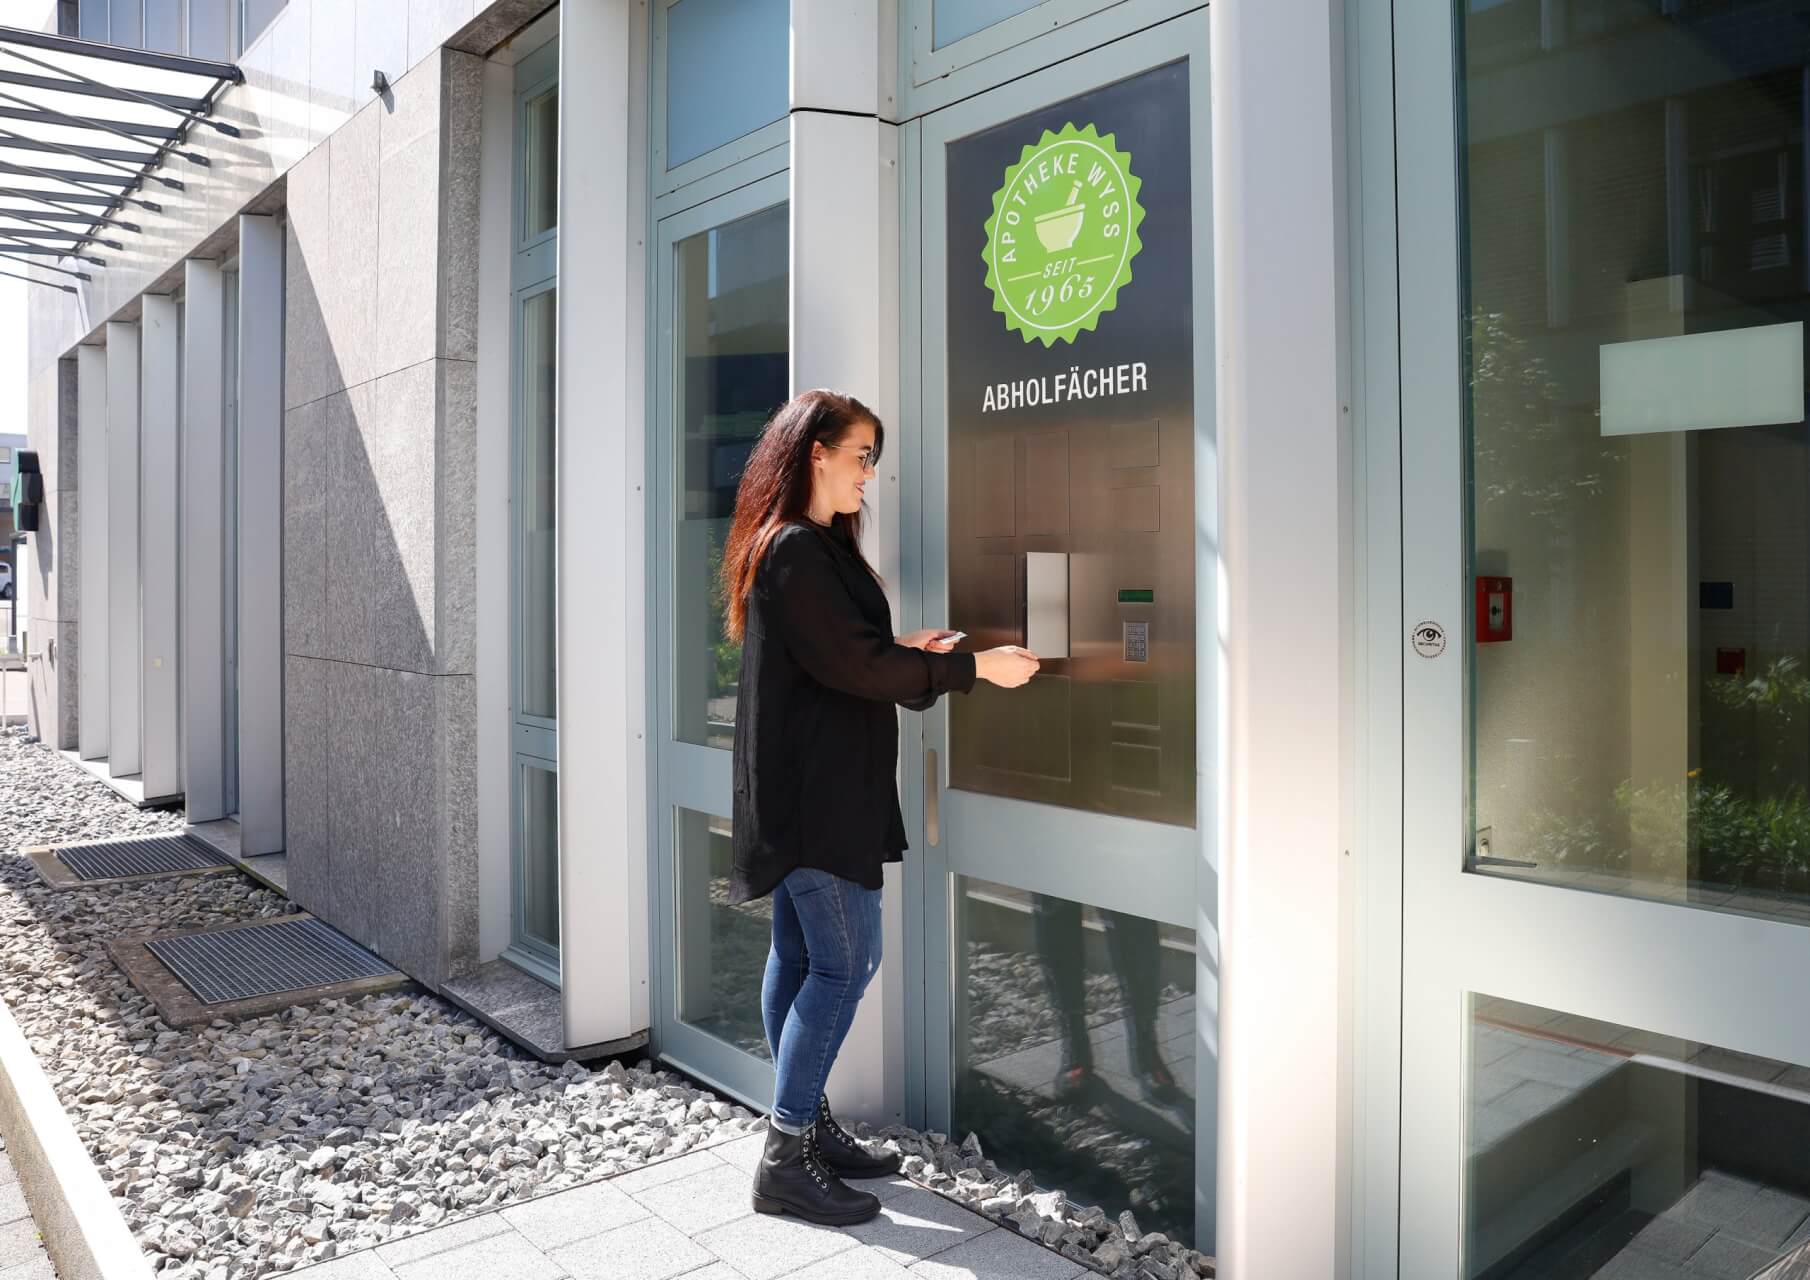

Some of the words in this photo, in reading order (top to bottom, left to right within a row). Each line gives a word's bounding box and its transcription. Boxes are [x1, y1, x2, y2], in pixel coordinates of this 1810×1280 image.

[1001, 152, 1080, 263] APOTHEKE
[1087, 161, 1121, 238] WYSS
[1042, 256, 1077, 279] SEIT
[1025, 275, 1096, 316] 1965
[982, 361, 1148, 413] ABHOLFÄCHER
